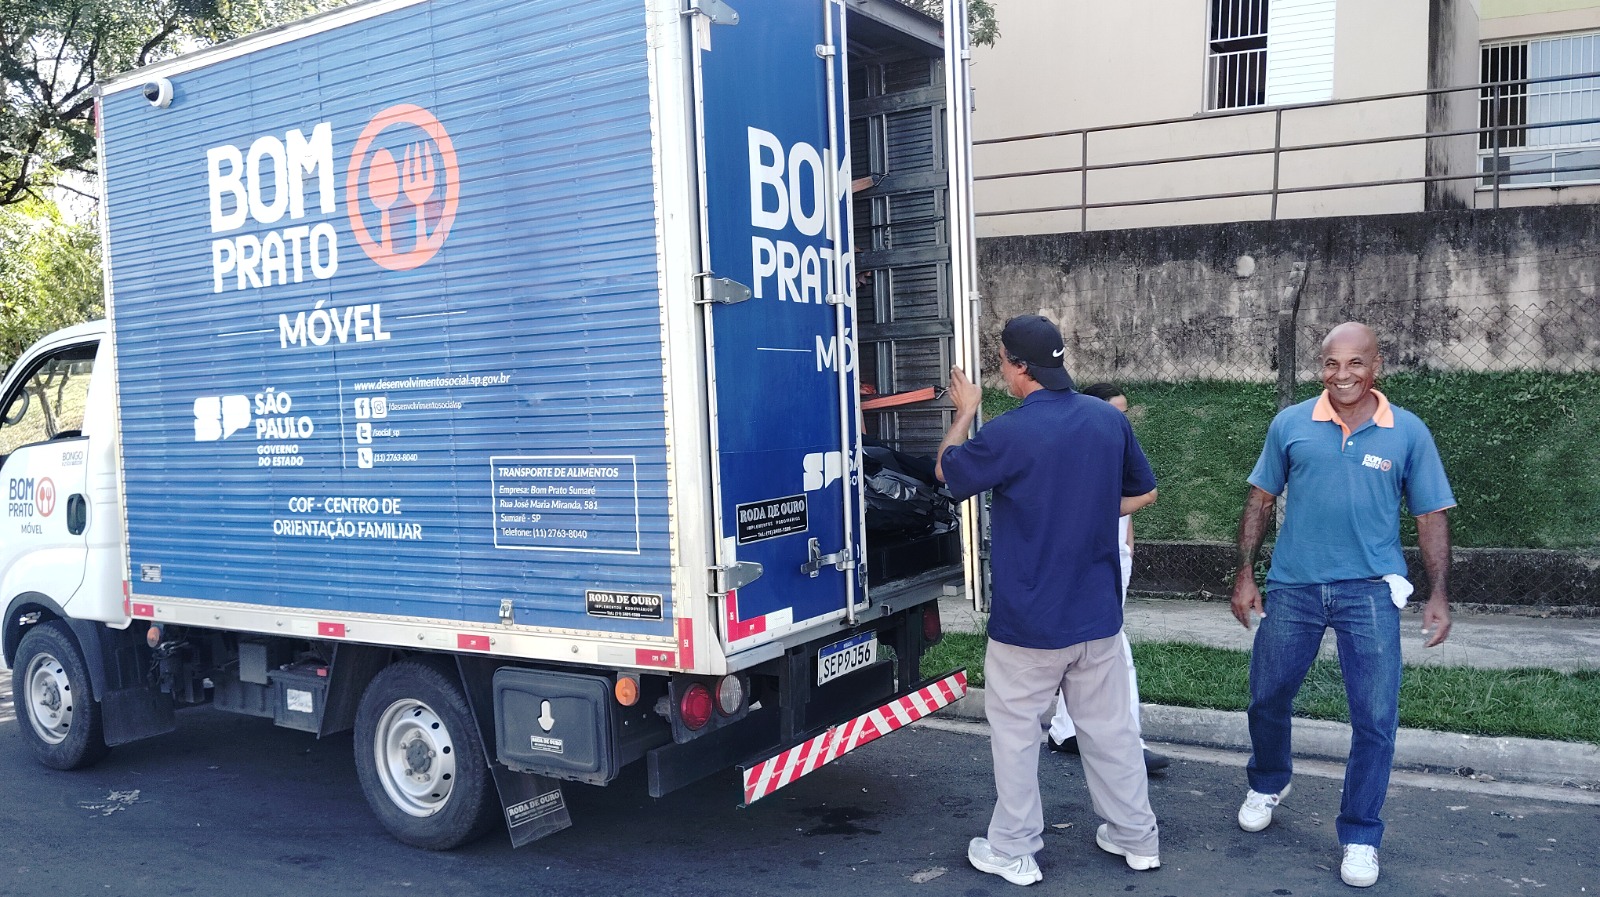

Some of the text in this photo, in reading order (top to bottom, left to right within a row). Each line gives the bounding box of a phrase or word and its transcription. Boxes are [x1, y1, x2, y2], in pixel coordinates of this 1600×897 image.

[207, 121, 335, 233] BOM
[212, 222, 338, 293] PRATO
[279, 299, 391, 348] MÓVEL
[354, 371, 511, 391] www.desenvolvimentosocial.sp.gov.br
[254, 387, 292, 415] SÃO
[255, 416, 314, 440] PAULO
[62, 451, 83, 461] BONGO
[256, 444, 299, 455] GOVERNO
[386, 453, 418, 462] 2763-8040
[258, 455, 304, 467] DO ESTADO
[1363, 453, 1382, 465] BOM
[499, 467, 619, 478] TRANSPORTE DE ALIMENTOS
[9, 478, 34, 501] BOM
[499, 485, 596, 496] Empresa: Bom Prato Sumaré
[8, 502, 34, 518] PRATO
[288, 497, 315, 513] COF
[324, 497, 379, 514] CENTRO
[382, 498, 402, 515] DE
[500, 499, 598, 511] Rua José Maria Miranda, 581
[739, 499, 805, 523] RODA DE OURO
[500, 513, 526, 523] Sumaré
[531, 514, 541, 523] SP
[21, 522, 43, 534] MÓVEL
[273, 517, 423, 540] ORIENTAÇÃO FAMILIAR
[501, 528, 588, 539] Telefone: (11) 2763-8040
[588, 593, 659, 606] RODA DE OURO
[824, 642, 871, 679] SEP9J56
[508, 803, 530, 816] RODA
[529, 799, 540, 809] DE
[540, 792, 560, 804] OURO
